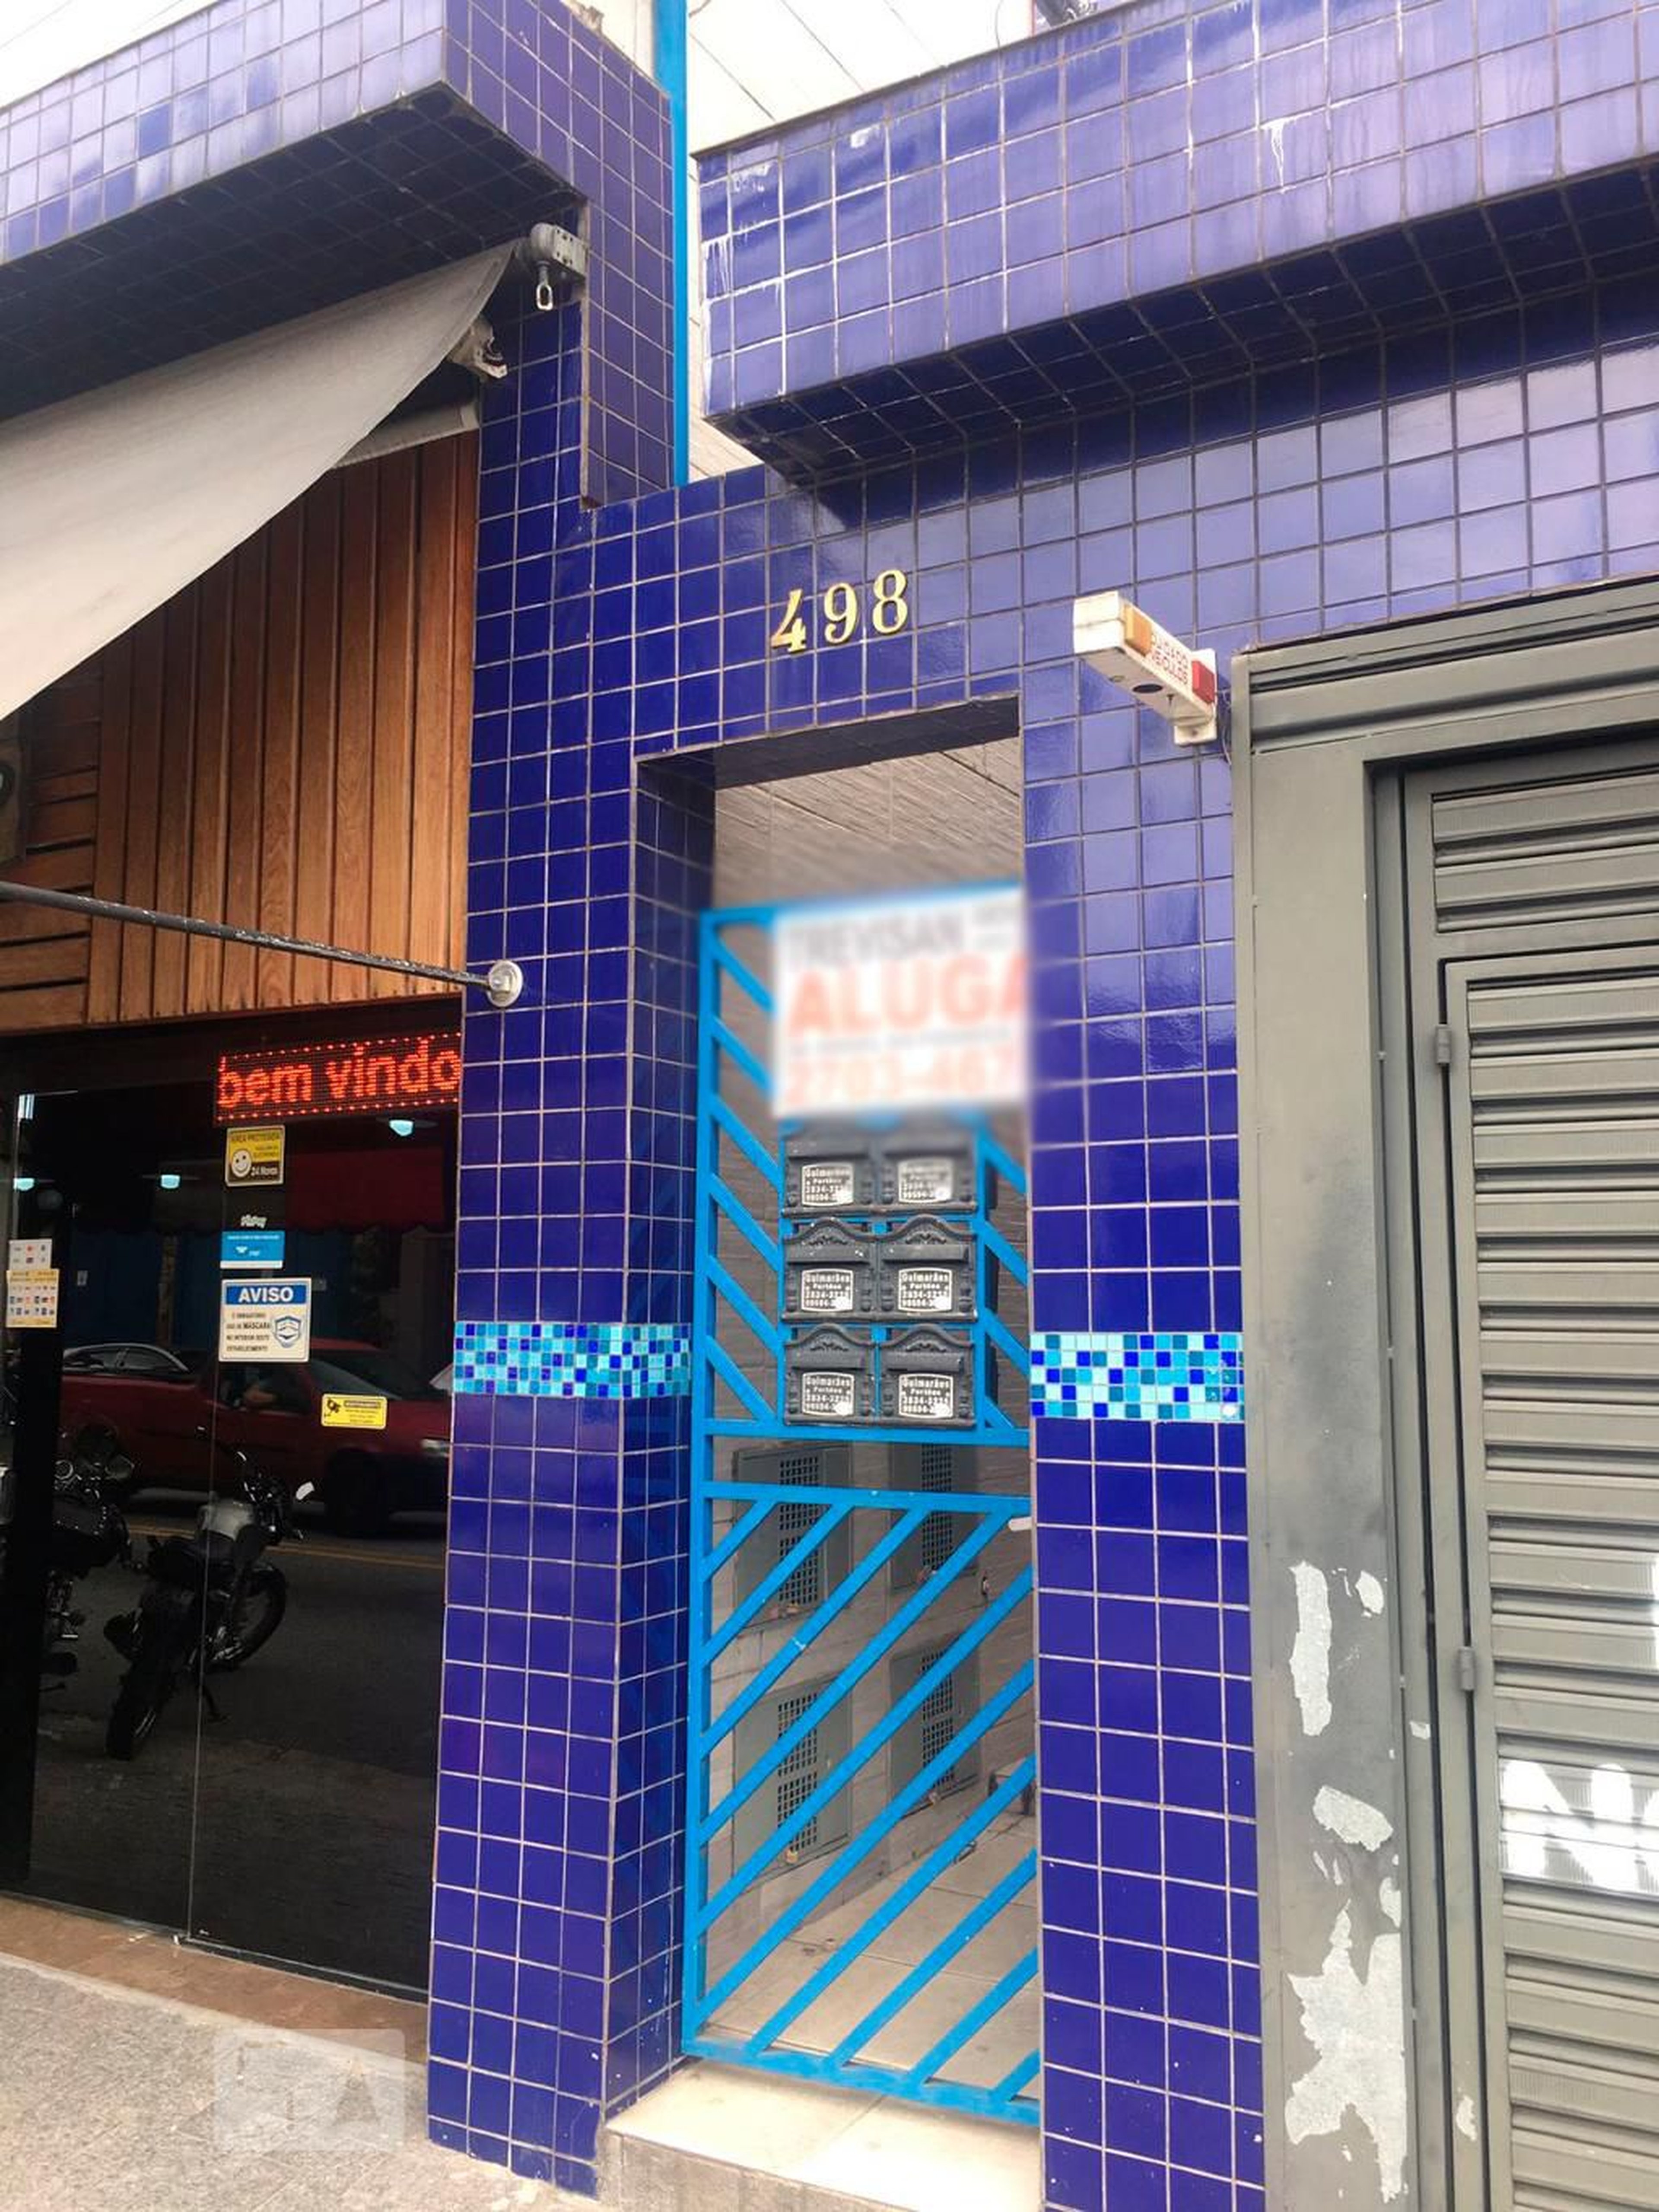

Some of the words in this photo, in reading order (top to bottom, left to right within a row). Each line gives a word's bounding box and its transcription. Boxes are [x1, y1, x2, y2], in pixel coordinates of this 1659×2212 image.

[771, 570, 908, 652] 498
[217, 1056, 312, 1108] bem
[325, 1039, 461, 1098] vindo
[238, 1286, 293, 1303] AVISO
